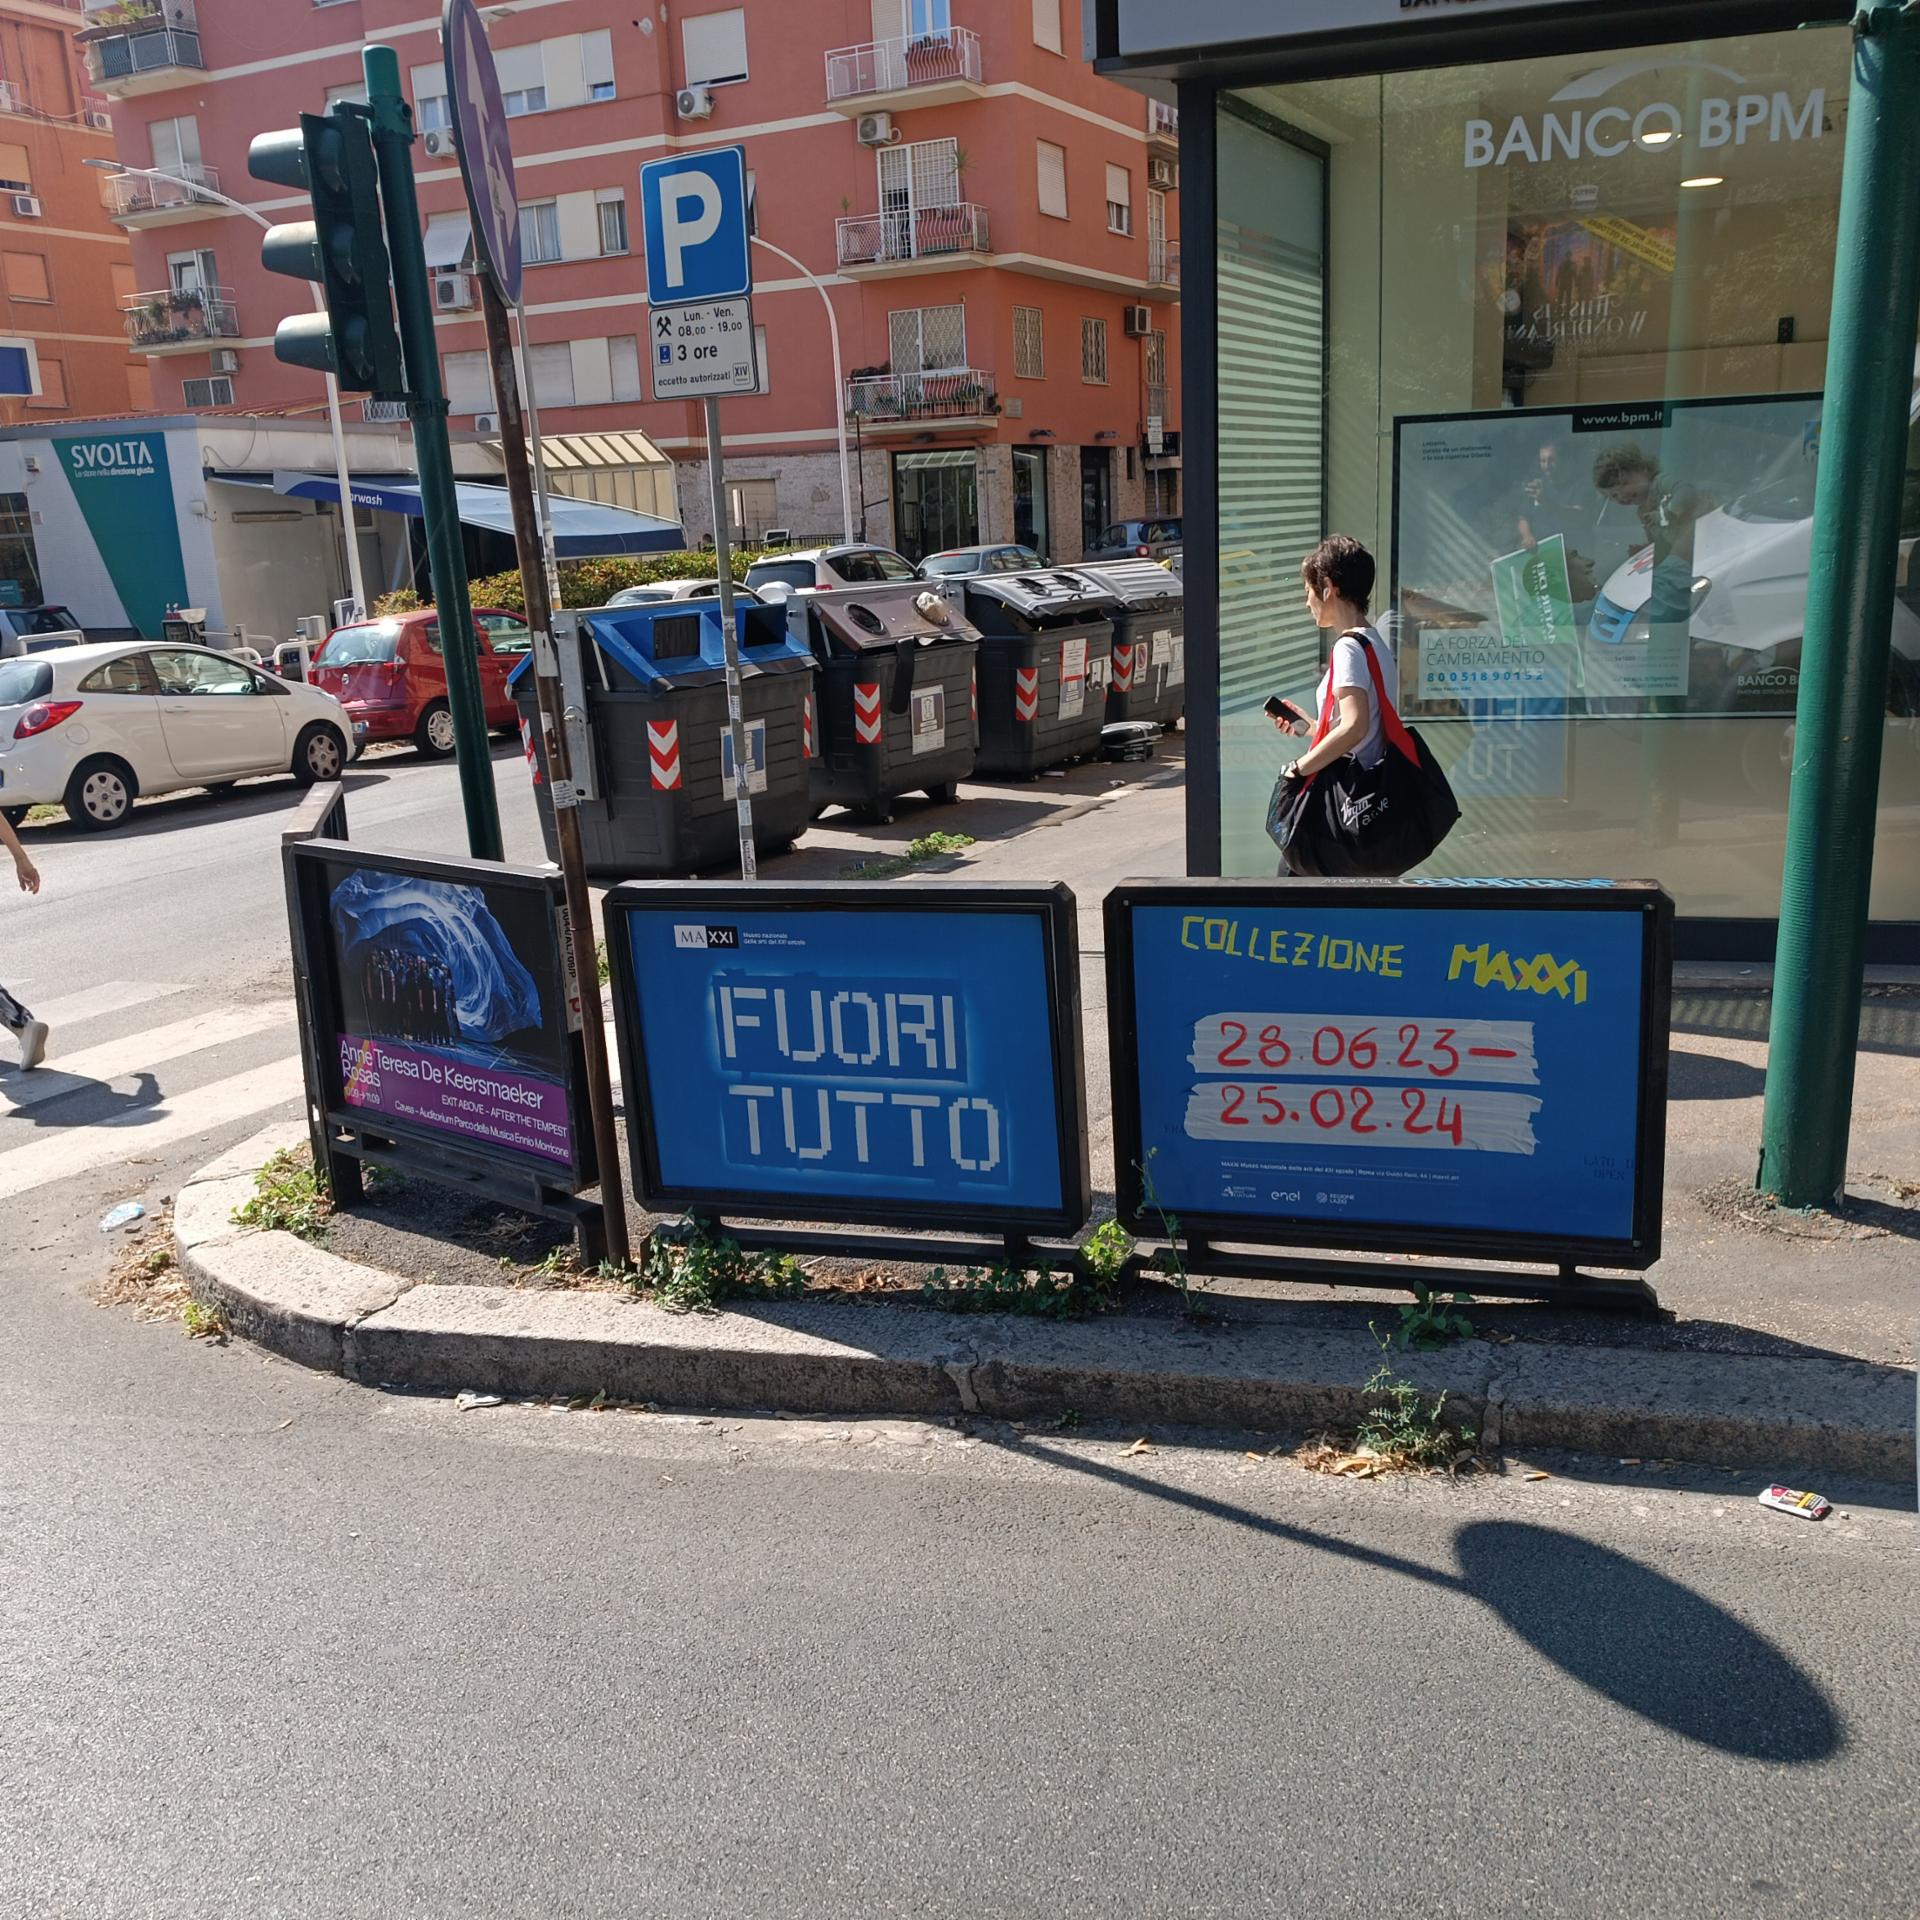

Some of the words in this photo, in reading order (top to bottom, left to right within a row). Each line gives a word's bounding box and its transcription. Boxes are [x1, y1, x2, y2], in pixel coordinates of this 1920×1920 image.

[1464, 102, 1682, 168] BANCO
[1699, 89, 1825, 148] BPM
[659, 171, 722, 287] P
[683, 311, 704, 322] Lun.
[713, 307, 734, 318] Ven.
[677, 344, 687, 361] 3
[694, 345, 718, 359] ore
[658, 376, 687, 386] eccetto
[690, 371, 731, 384] autorizzati
[734, 366, 748, 377] XIV
[1582, 410, 1662, 425] www.bpm.it
[71, 441, 153, 468] SVOLTA
[1427, 638, 1444, 650] LA
[1449, 636, 1496, 649] FORZA
[1501, 635, 1529, 648] DEL
[1426, 651, 1545, 666] CAMBIAMENTO
[1737, 674, 1786, 686] BANCO
[1340, 792, 1376, 829] Virgin
[1181, 916, 1405, 977] COLLEZIONE
[1448, 943, 1587, 1005] MAXXI
[720, 986, 956, 1070] FUORI
[340, 1040, 373, 1066] Anne
[373, 1048, 419, 1079] Teresa
[421, 1060, 442, 1084] De
[444, 1065, 543, 1109] Keersmaeker
[342, 1059, 381, 1087] Rosas
[441, 1094, 458, 1107] EXIT
[458, 1100, 484, 1115] ABOVE
[490, 1107, 516, 1123] AFTER
[516, 1114, 533, 1128] THE
[533, 1118, 567, 1138] TEMPEST
[729, 1084, 1000, 1172] TUTTO
[1220, 1085, 1462, 1145] 25.02.24
[420, 1106, 454, 1124] Auditorium
[454, 1116, 474, 1130] Parco
[474, 1122, 489, 1134] della
[490, 1126, 514, 1141] Musica
[515, 1132, 534, 1147] Ennio
[535, 1138, 569, 1158] Morricone
[1271, 1190, 1300, 1201] enel
